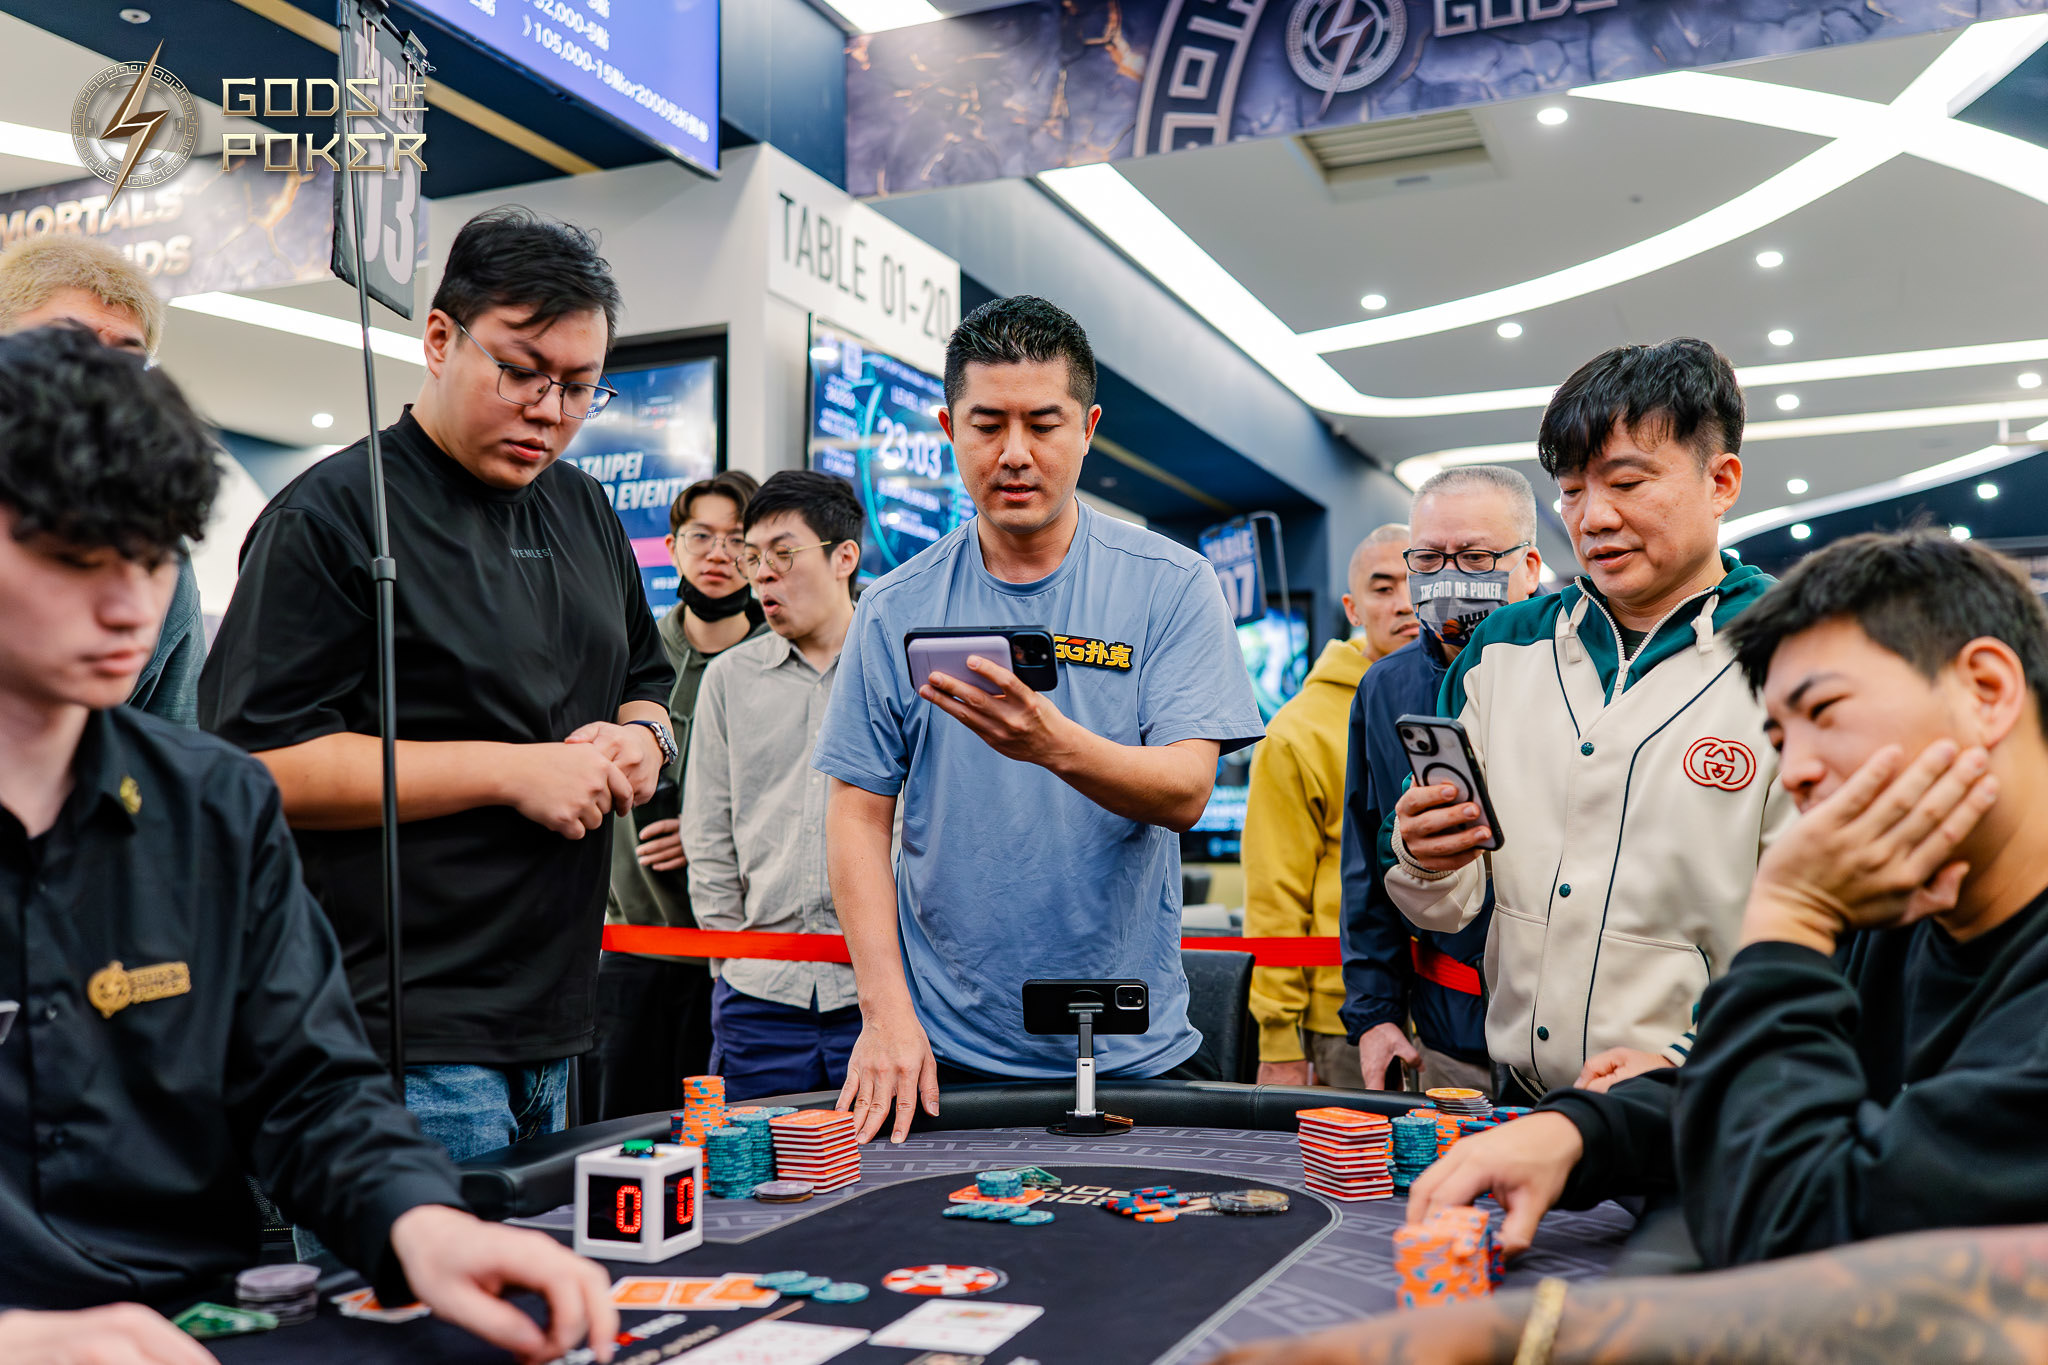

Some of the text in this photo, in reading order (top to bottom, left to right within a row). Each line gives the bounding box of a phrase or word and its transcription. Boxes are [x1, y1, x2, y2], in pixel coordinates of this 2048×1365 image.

[1434, 0, 1618, 37] GO
[778, 191, 952, 346] TABLE 01-20
[579, 451, 644, 484] TAIPEI
[876, 415, 943, 480] 23:03
[1432, 581, 1452, 598] GOD
[1454, 582, 1468, 597] OF
[1469, 582, 1502, 598] POKER
[616, 1185, 642, 1234] 0
[677, 1176, 694, 1225] 0
